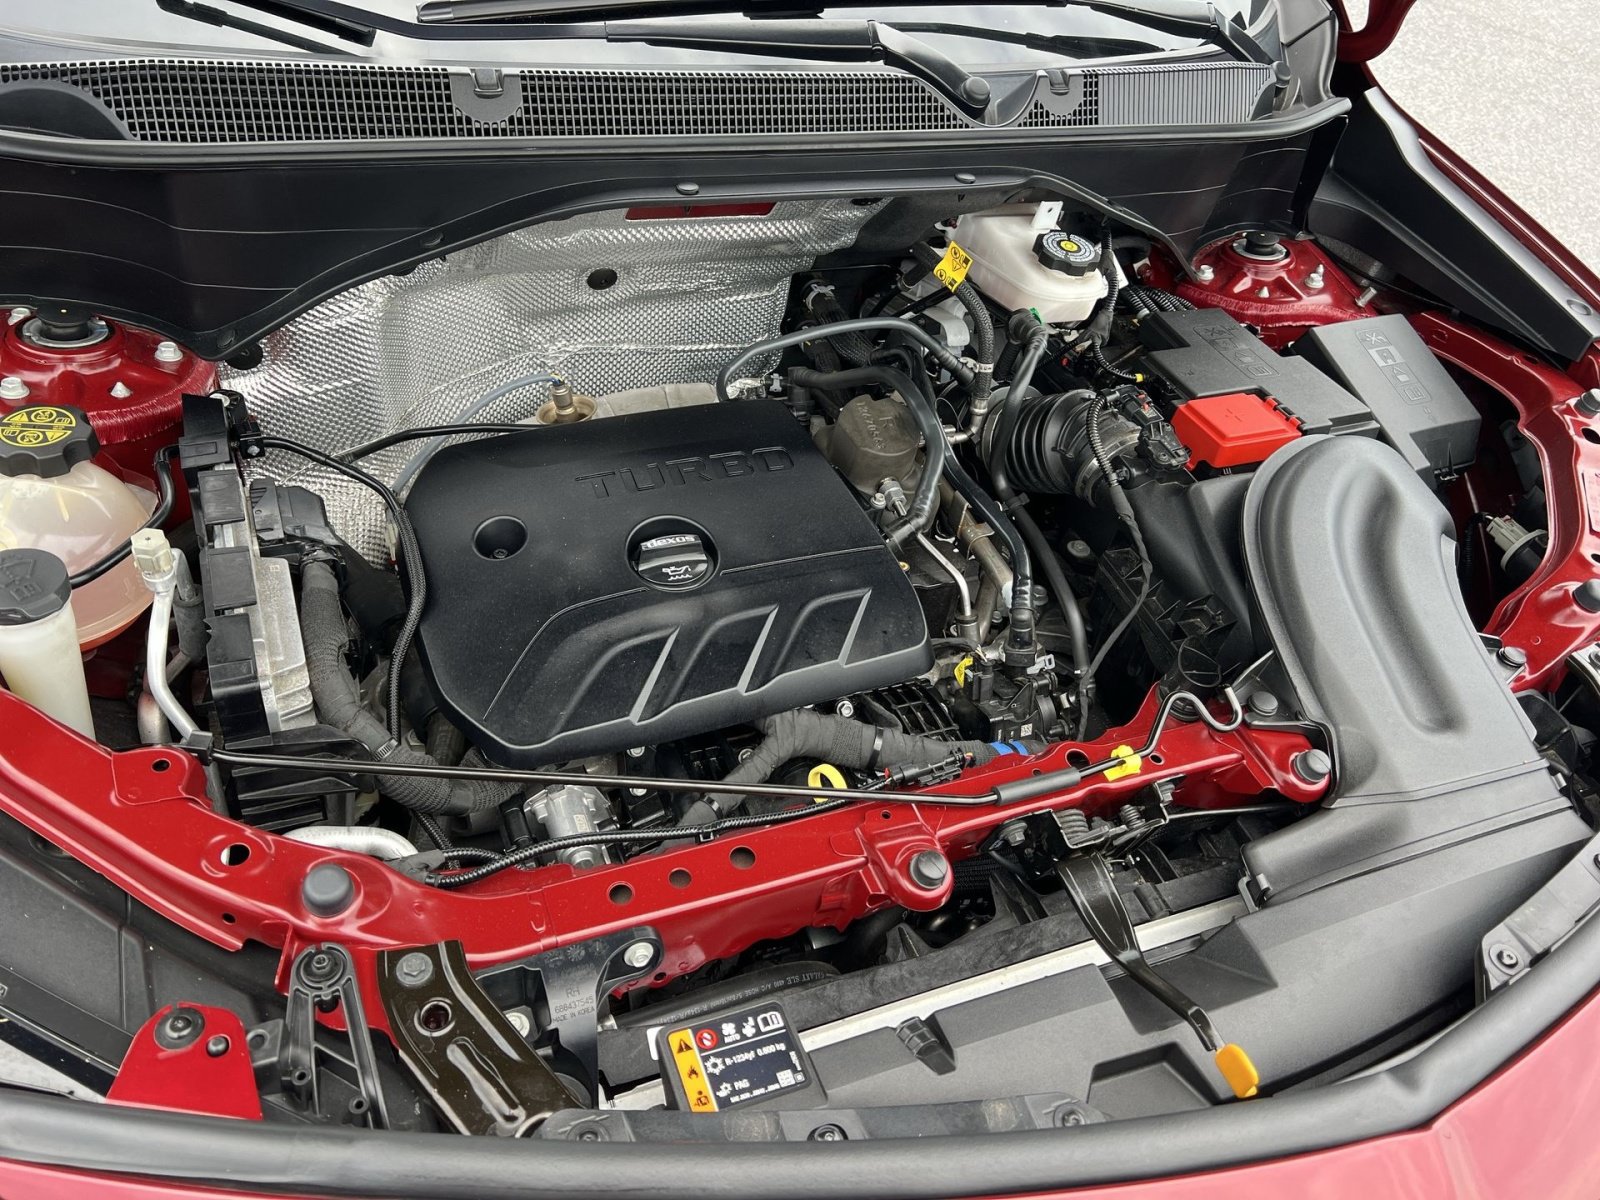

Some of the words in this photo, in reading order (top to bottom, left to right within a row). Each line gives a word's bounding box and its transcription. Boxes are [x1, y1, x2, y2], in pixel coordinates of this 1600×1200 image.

[575, 446, 794, 499] TURBO
[646, 535, 695, 549] dexos
[786, 975, 800, 985] SLE
[566, 987, 580, 998] RH
[744, 987, 759, 997] HOSE
[761, 983, 772, 992] A/C
[552, 1013, 568, 1023] MADE
[577, 1006, 596, 1016] KOREA
[724, 1033, 741, 1044] AUTO
[724, 1050, 755, 1066] R-1234yf
[774, 1042, 786, 1051] kg
[733, 1079, 750, 1091] PAG
